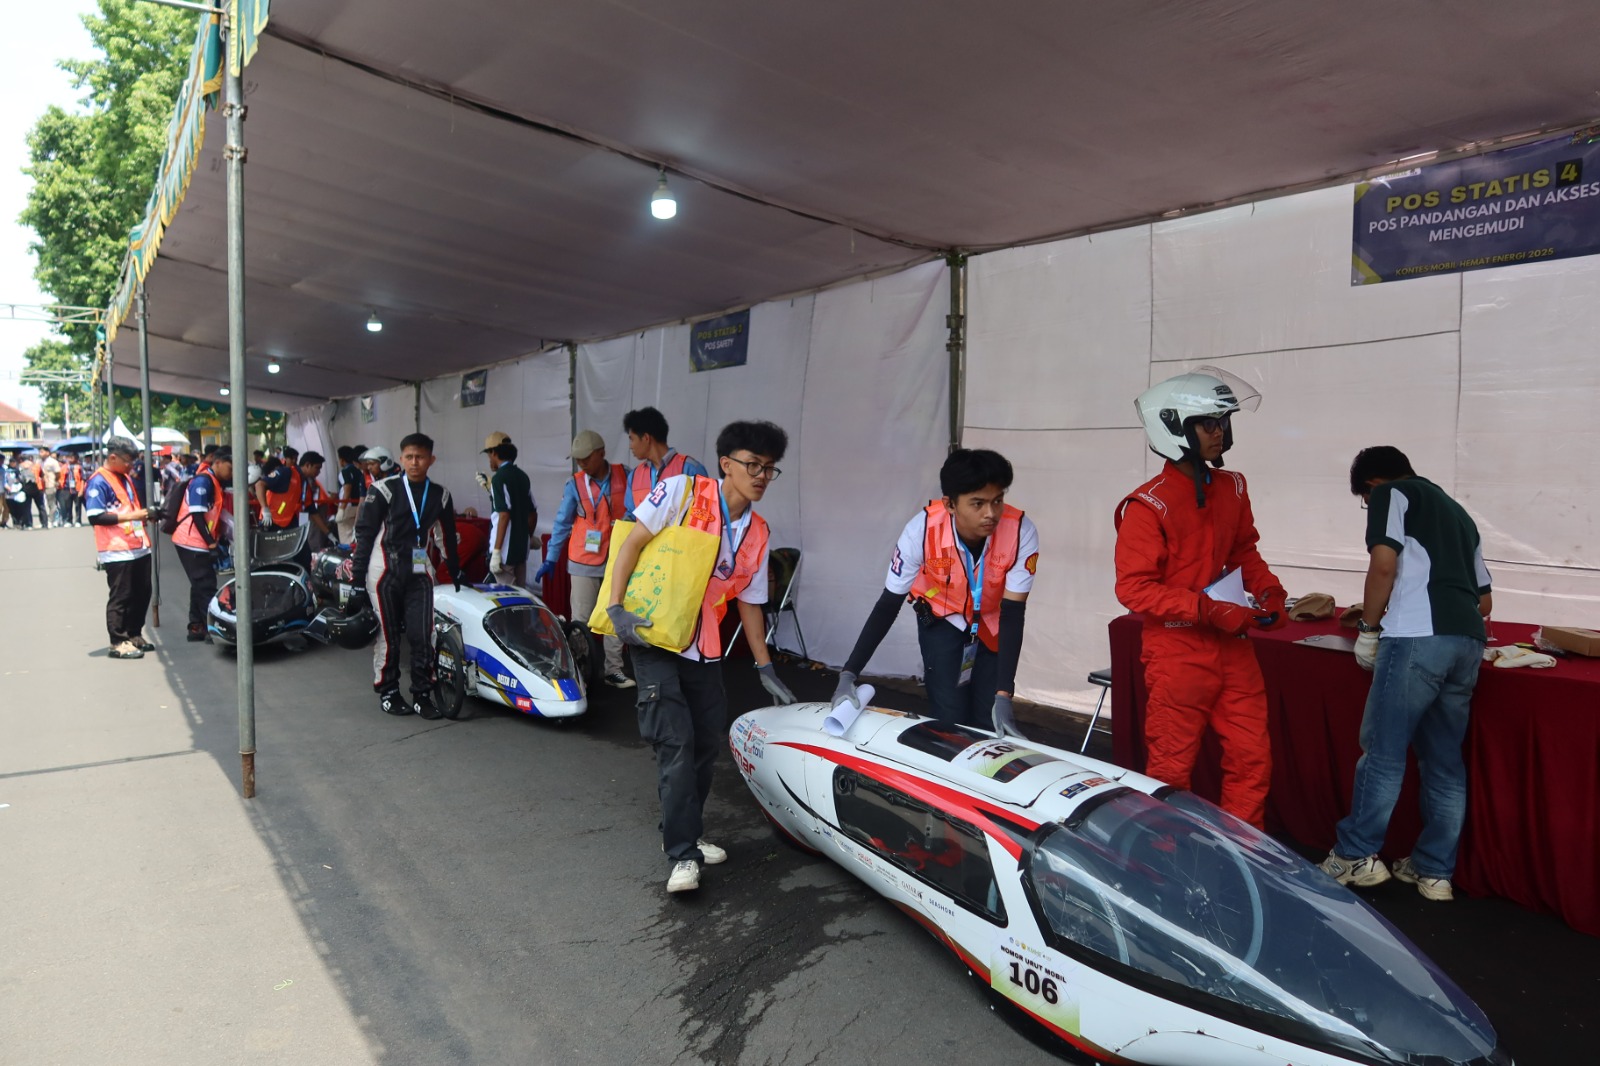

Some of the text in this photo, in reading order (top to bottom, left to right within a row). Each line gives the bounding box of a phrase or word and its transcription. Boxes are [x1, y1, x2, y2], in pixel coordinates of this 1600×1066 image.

[1386, 163, 1578, 213] POS STATIS 4
[1369, 182, 1600, 233] POS PANDANGAN DAN AKSES
[1429, 216, 1525, 242] MENGEMUDI
[1396, 265, 1429, 277] KONTES
[1460, 257, 1490, 267] HEMAT
[1492, 253, 1527, 263] ENERGI
[1529, 248, 1554, 259] 2025
[704, 341, 716, 350] POS
[1000, 945, 1067, 983] NOMOR URUT MOBIL
[1009, 962, 1059, 1005] 106
